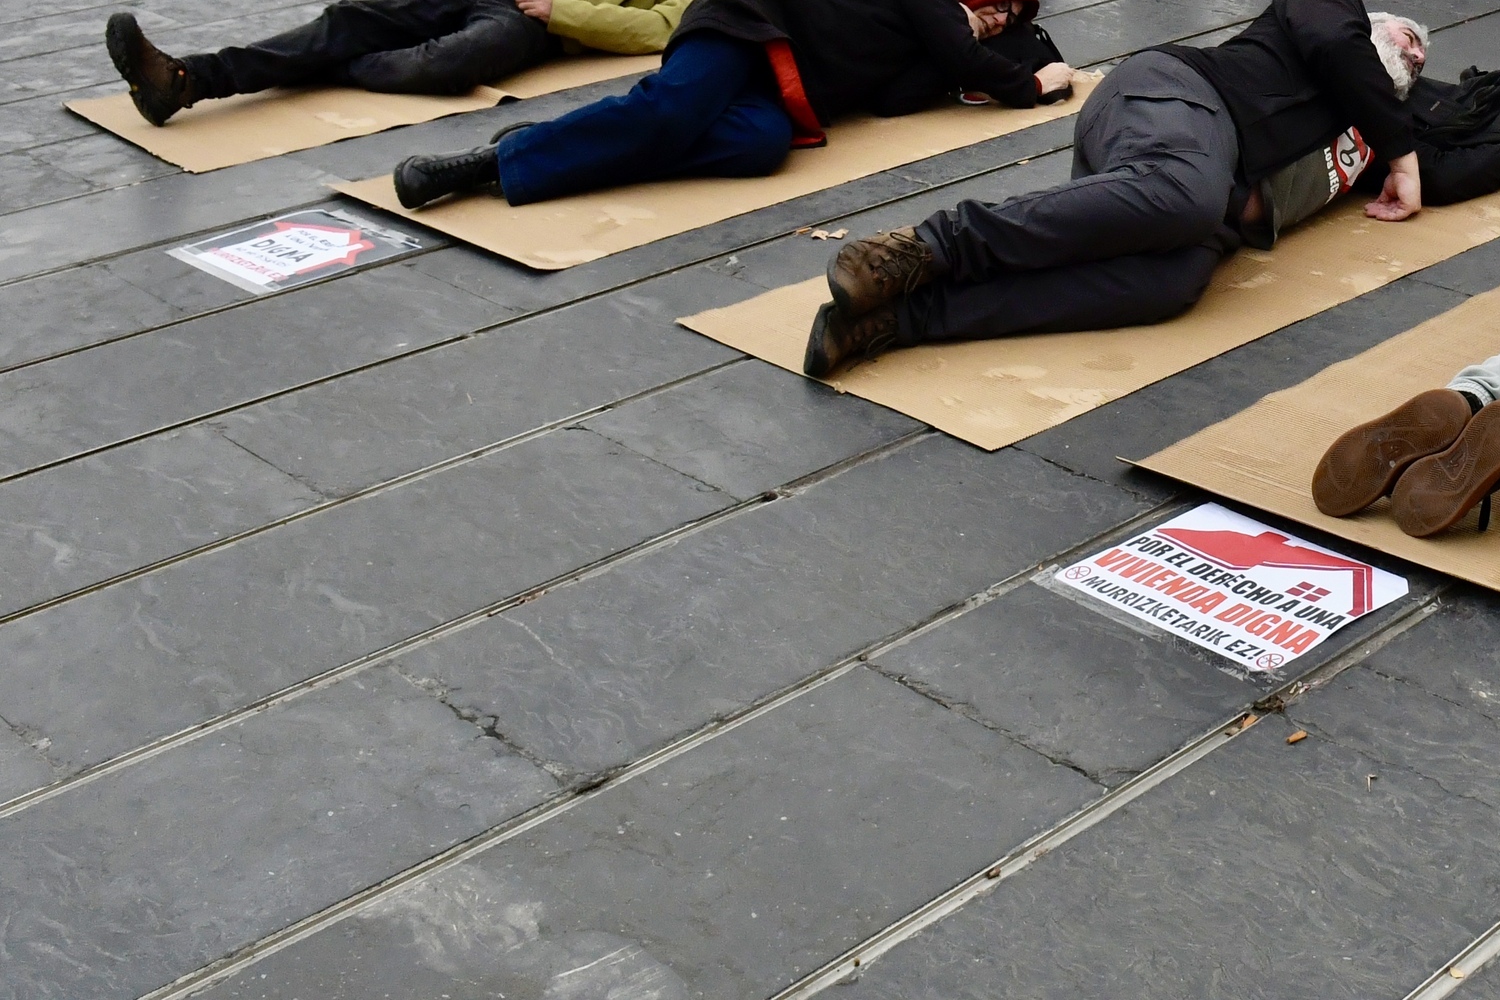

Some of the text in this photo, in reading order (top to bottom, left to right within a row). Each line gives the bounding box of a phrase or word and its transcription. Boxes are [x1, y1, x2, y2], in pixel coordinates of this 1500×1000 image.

[1323, 146, 1340, 194] LOS REC
[250, 238, 314, 263] DIGNA
[1080, 575, 1266, 660] MURRIZKETARIK EZ!
[1094, 548, 1321, 655] VIVIENDA DIGNA
[1126, 536, 1346, 630] POR EL DERECHO A UNA
